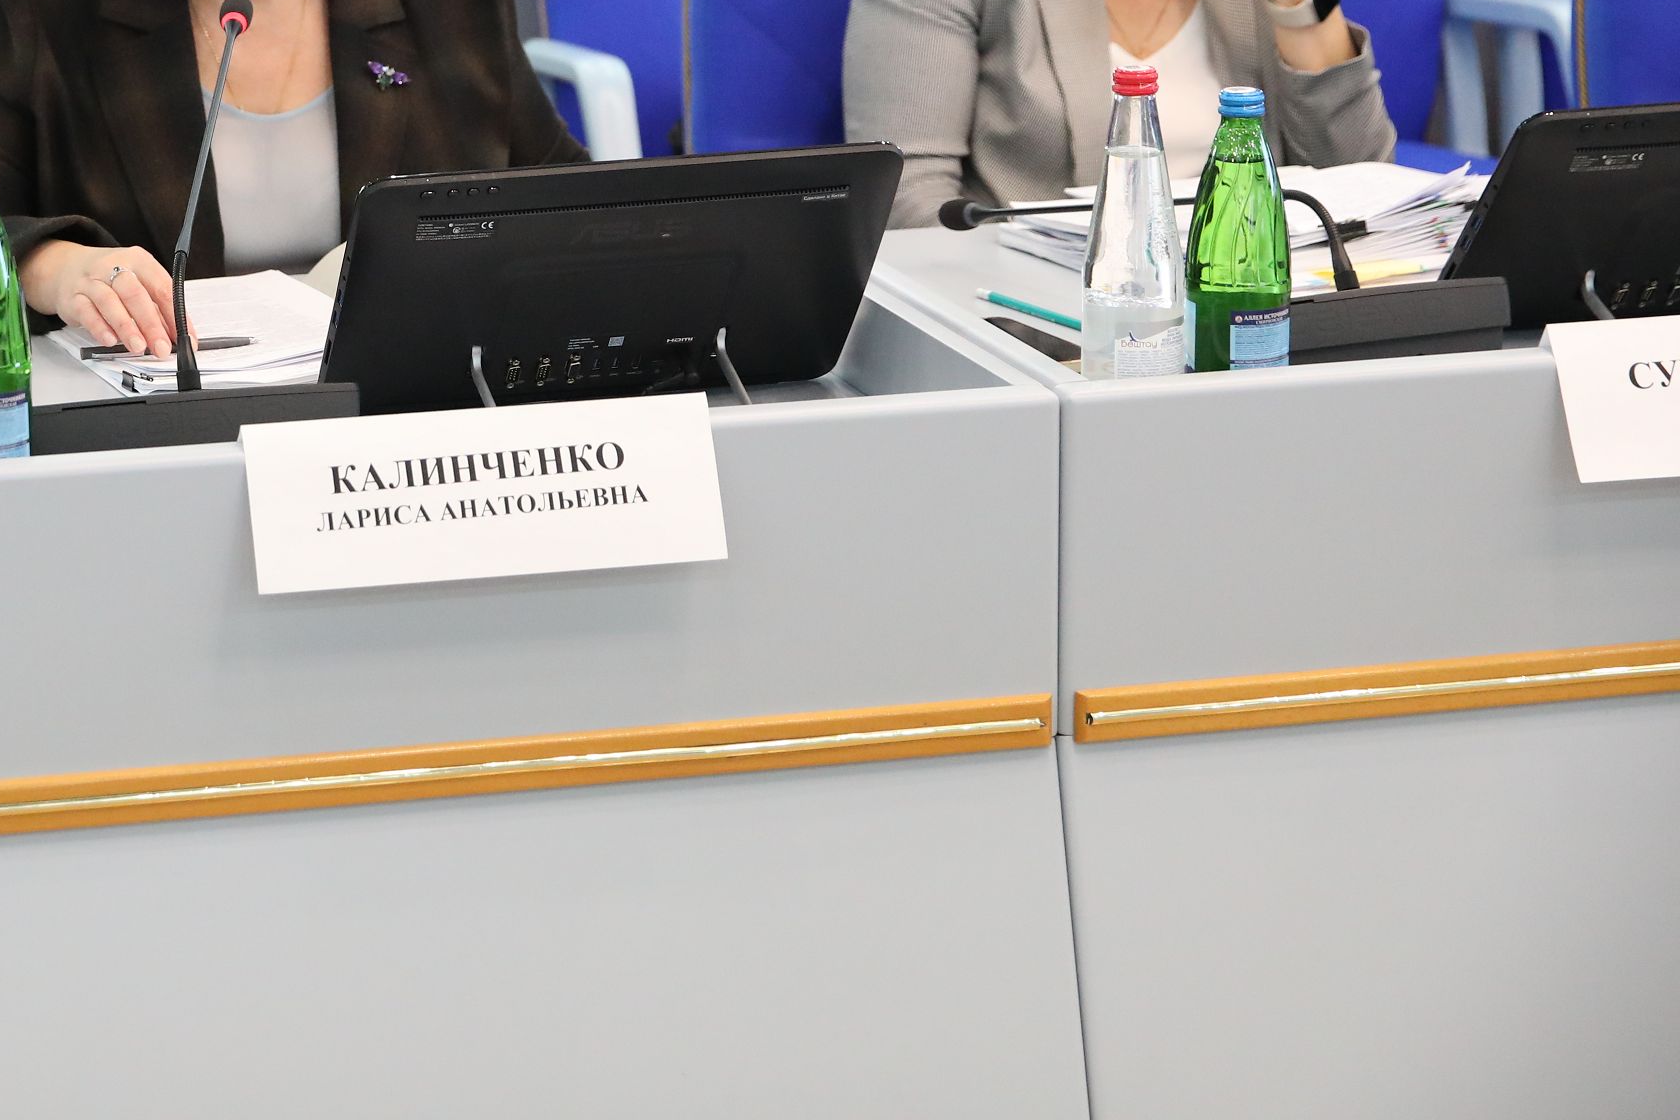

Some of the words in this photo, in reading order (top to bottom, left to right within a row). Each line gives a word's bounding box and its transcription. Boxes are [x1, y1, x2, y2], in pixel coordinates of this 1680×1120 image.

[328, 440, 626, 495] КАЛИНЧЕНКО
[315, 503, 433, 533] ЛАРИСА
[440, 483, 650, 521] АНАТОЛЬЕВНА
